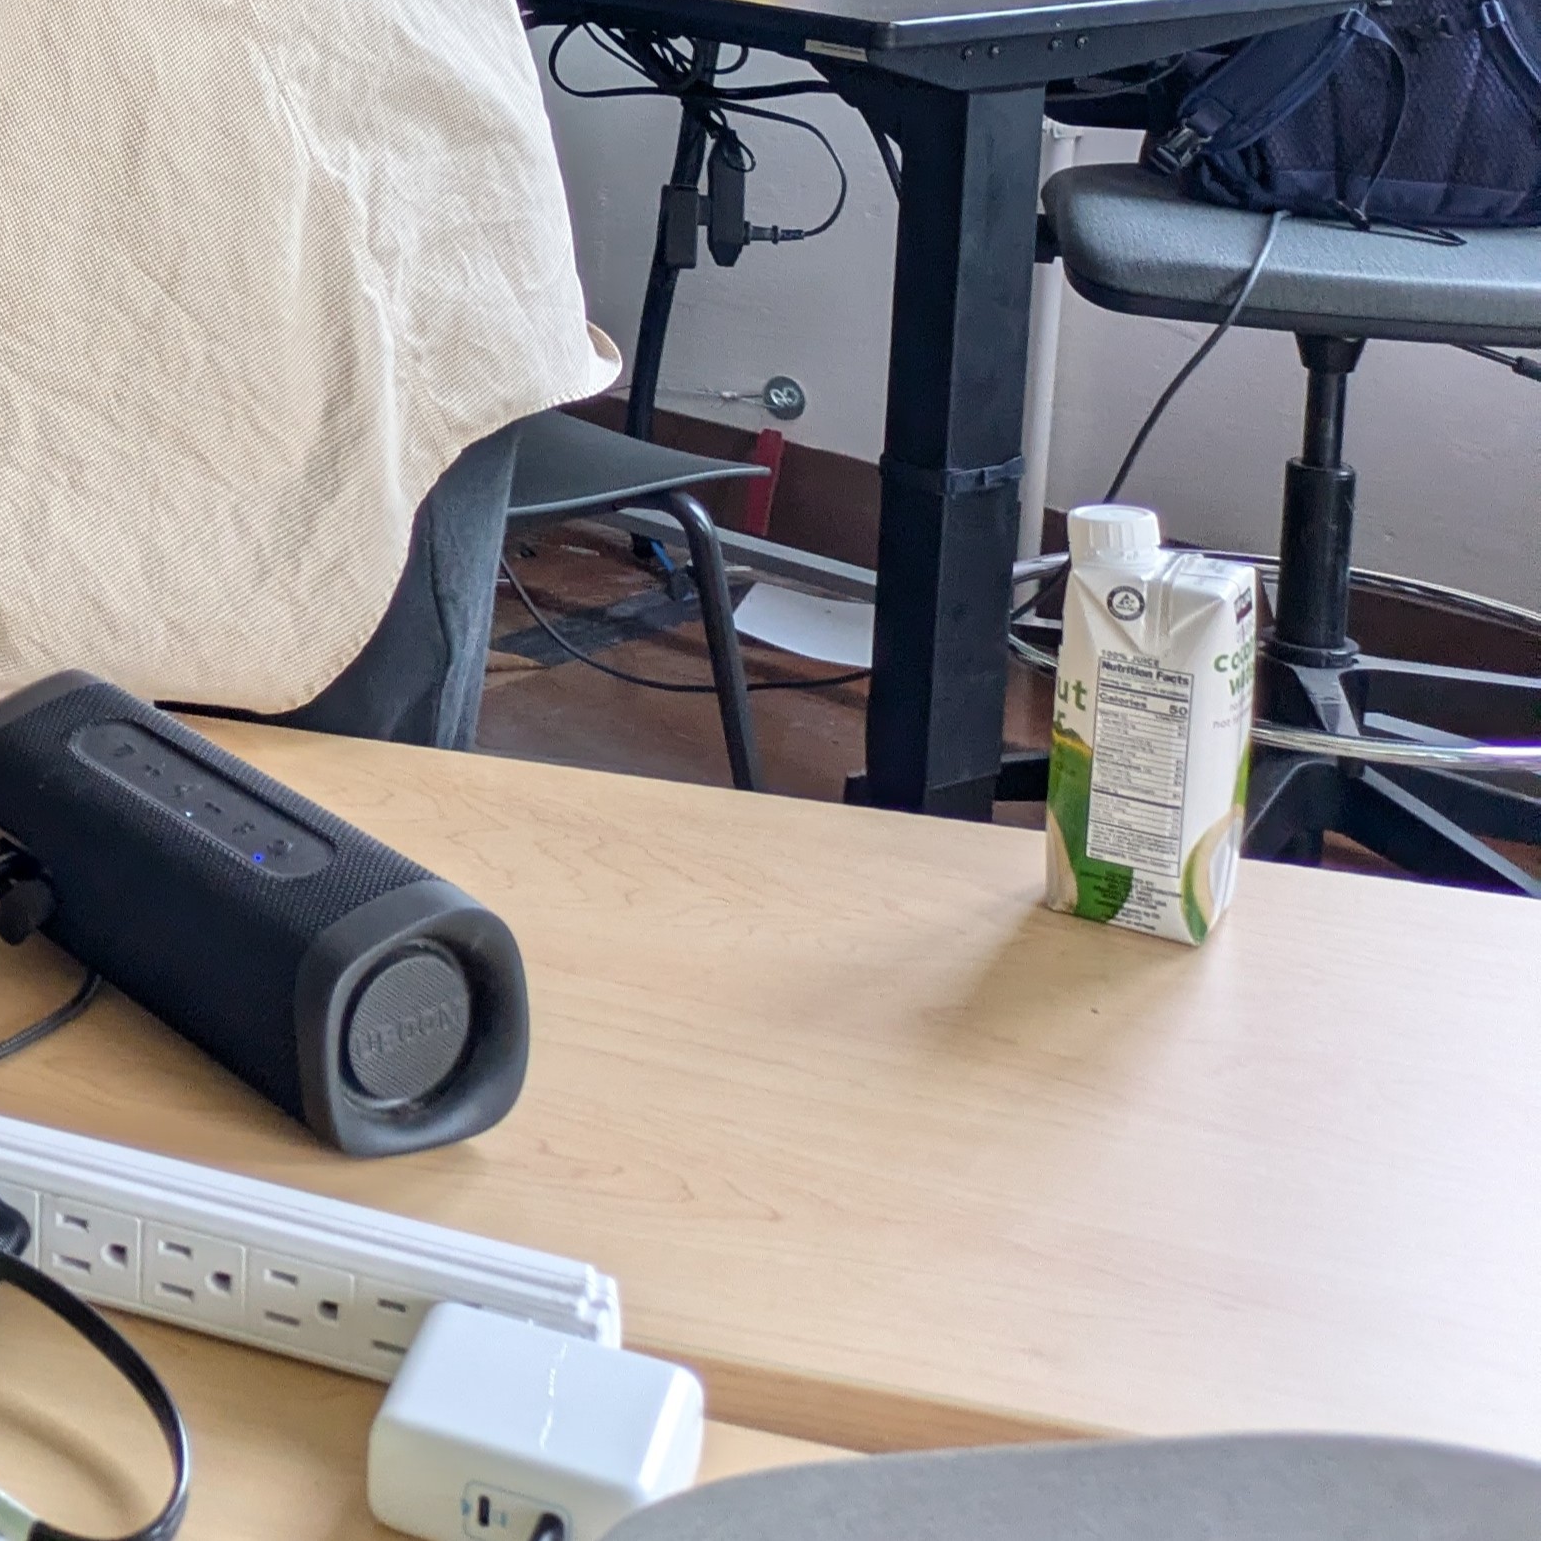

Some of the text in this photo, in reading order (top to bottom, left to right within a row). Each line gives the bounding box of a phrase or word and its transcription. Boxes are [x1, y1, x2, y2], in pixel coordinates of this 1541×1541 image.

[1101, 660, 1153, 678] Nutrition
[1156, 671, 1190, 686] Facts
[1099, 691, 1188, 716] Calories 50
